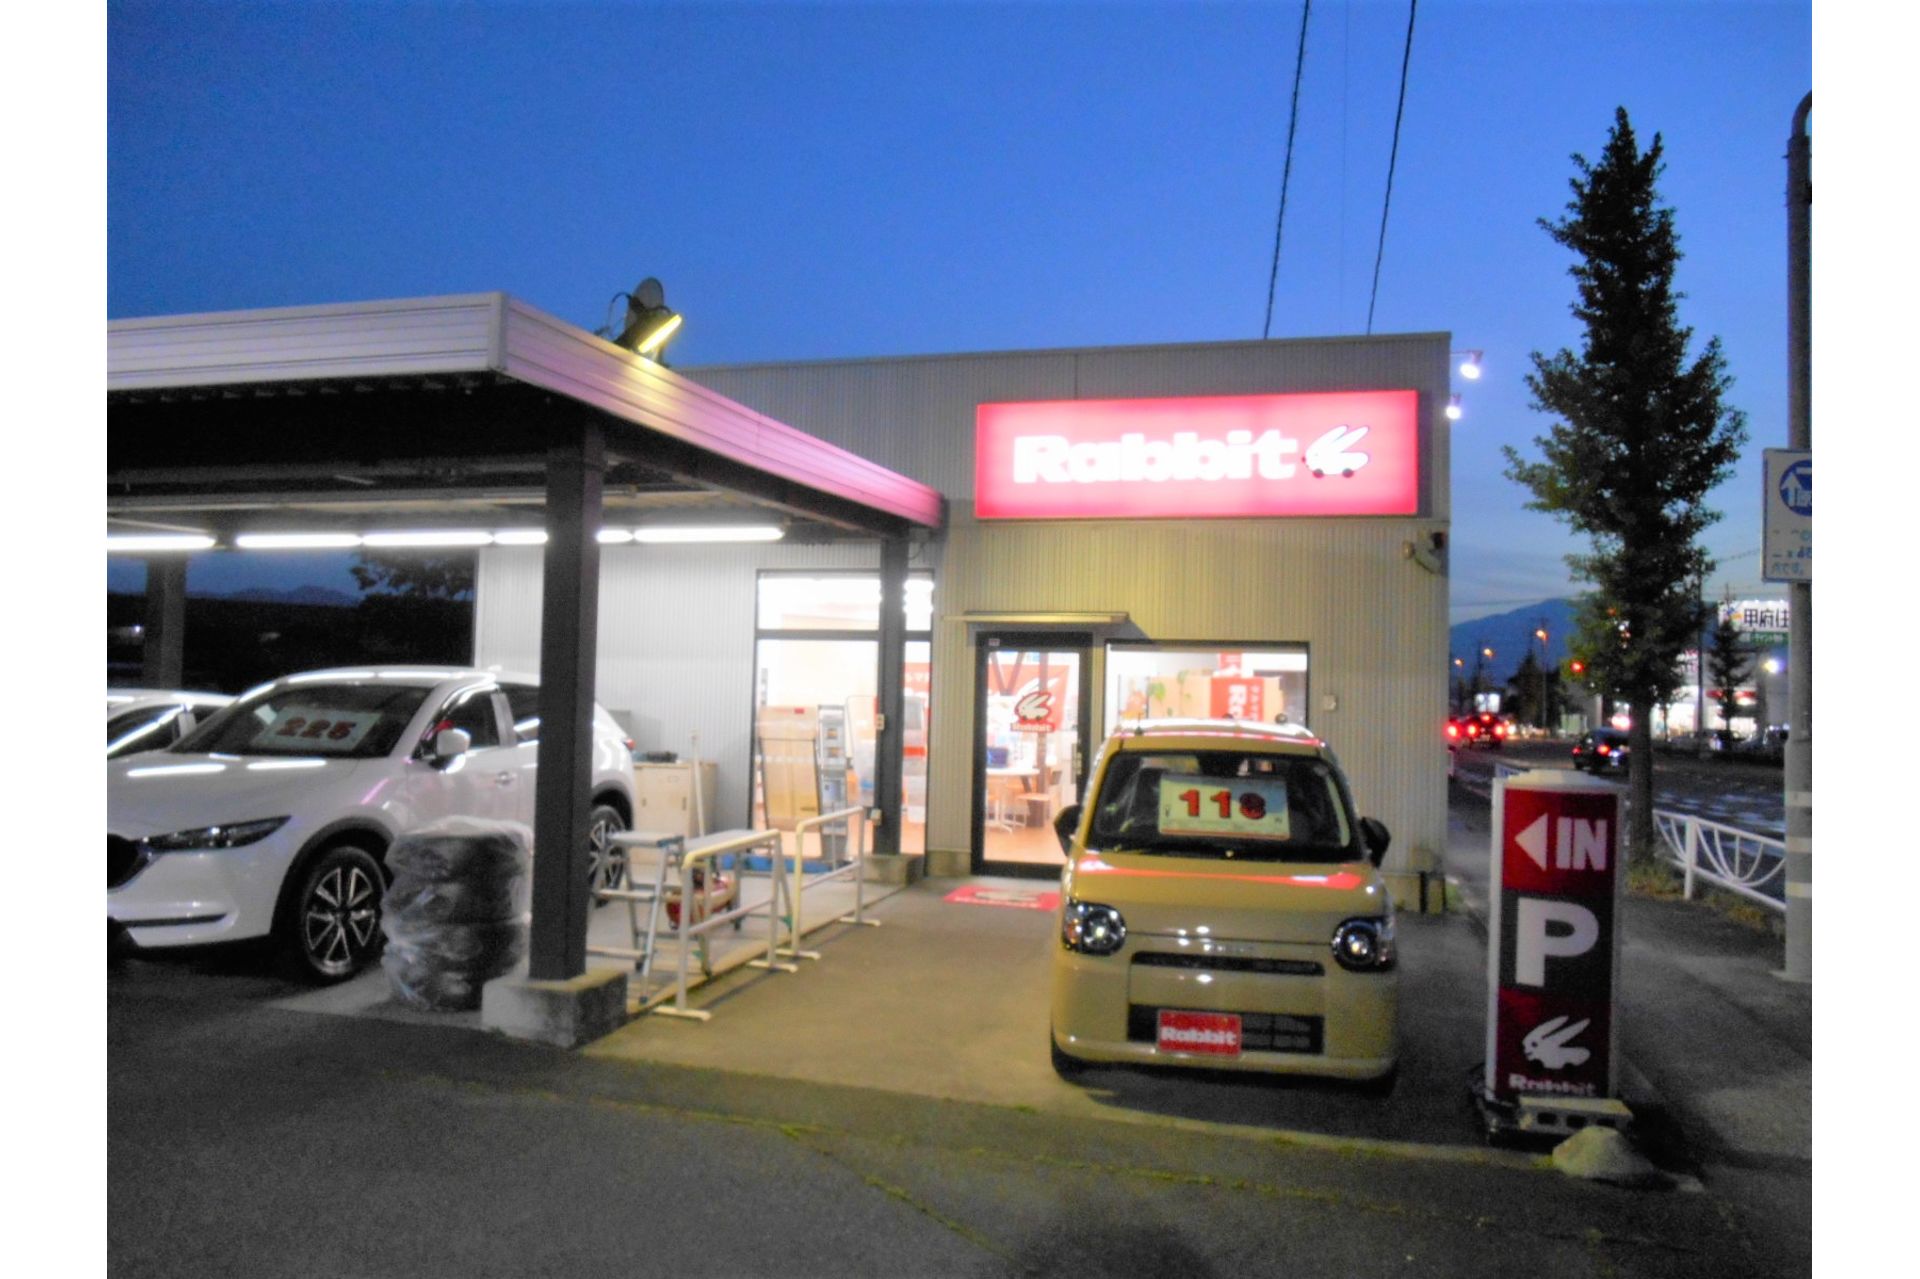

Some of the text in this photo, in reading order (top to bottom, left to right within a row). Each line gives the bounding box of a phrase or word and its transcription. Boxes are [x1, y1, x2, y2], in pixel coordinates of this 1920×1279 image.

[1014, 430, 1298, 483] Rabbit
[277, 717, 357, 740] 225
[1556, 817, 1607, 871] IN
[1516, 897, 1599, 987] P
[1161, 1026, 1238, 1045] Rabbit
